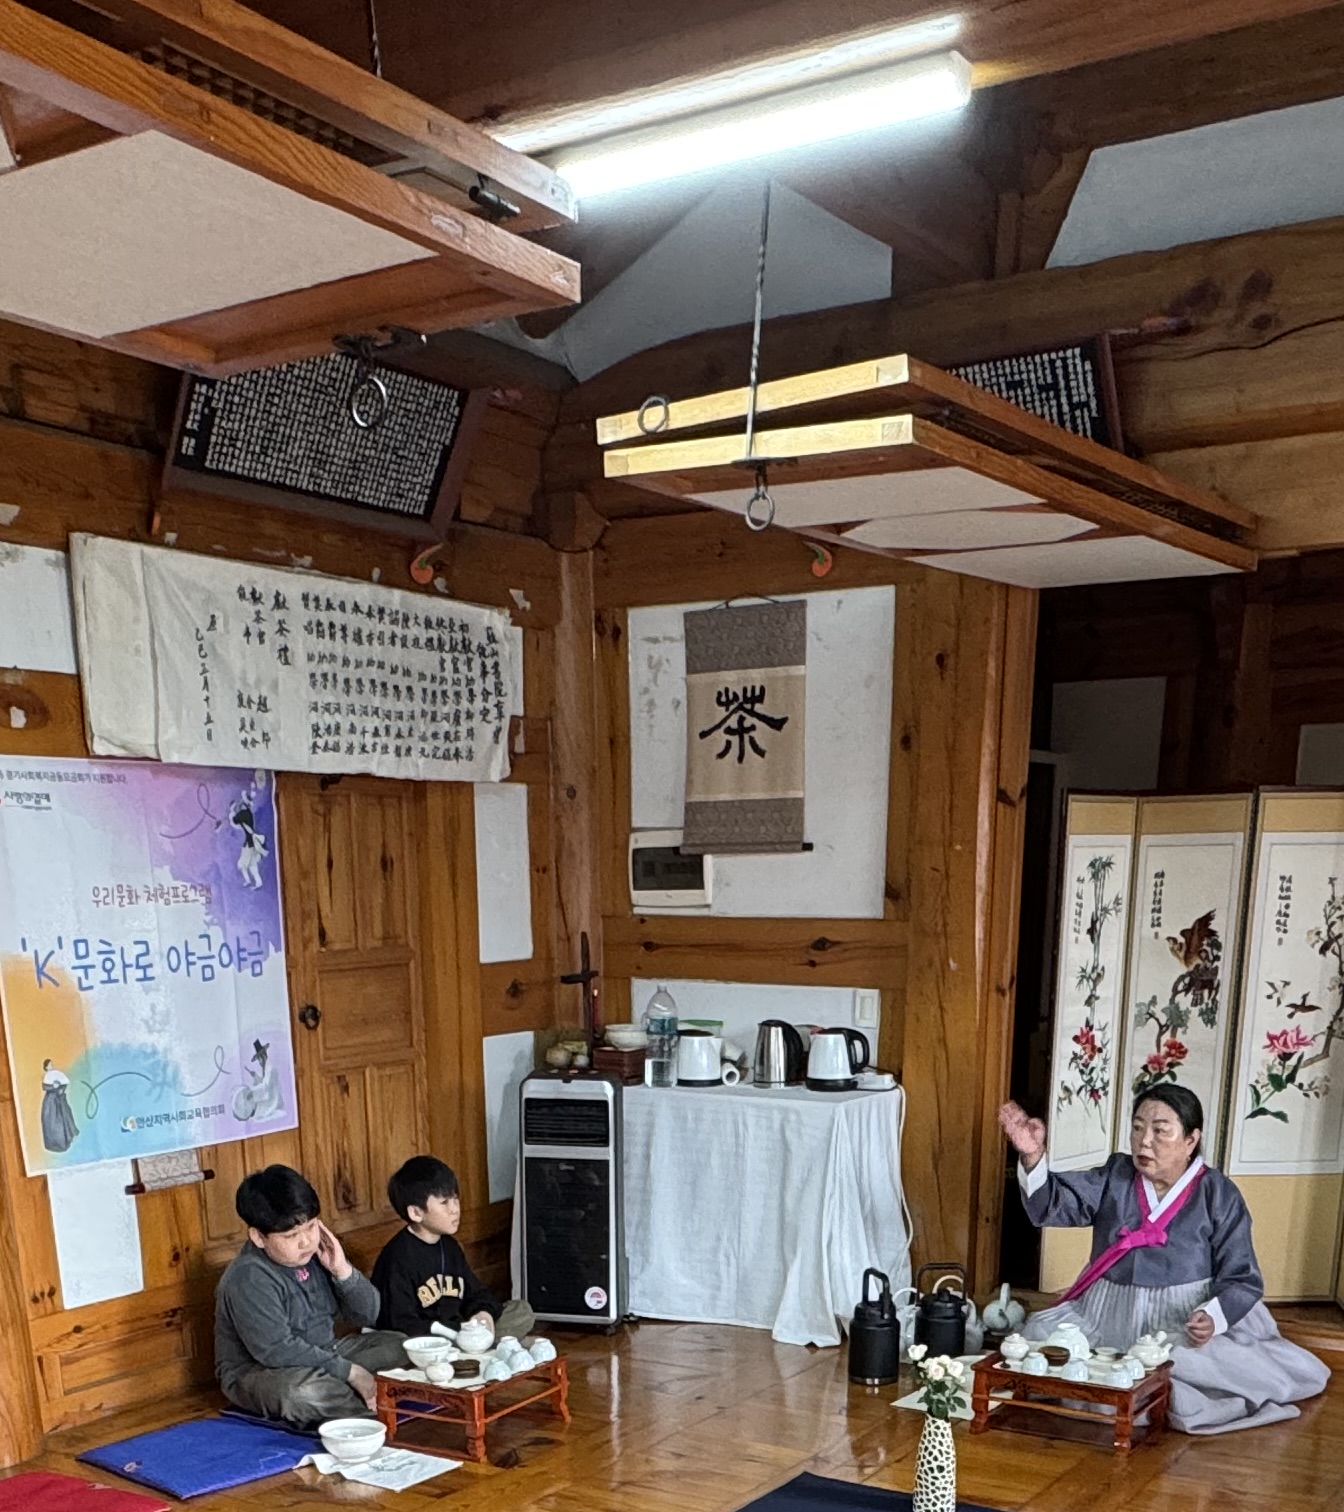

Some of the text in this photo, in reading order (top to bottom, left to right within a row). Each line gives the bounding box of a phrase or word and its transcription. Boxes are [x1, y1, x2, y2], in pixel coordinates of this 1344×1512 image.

[698, 684, 789, 765] 茶
[91, 881, 213, 909] 우리문화 체험프로그램
[166, 931, 264, 983] 야금야금
[135, 1104, 226, 1129] 안산지역사회교육협의회
